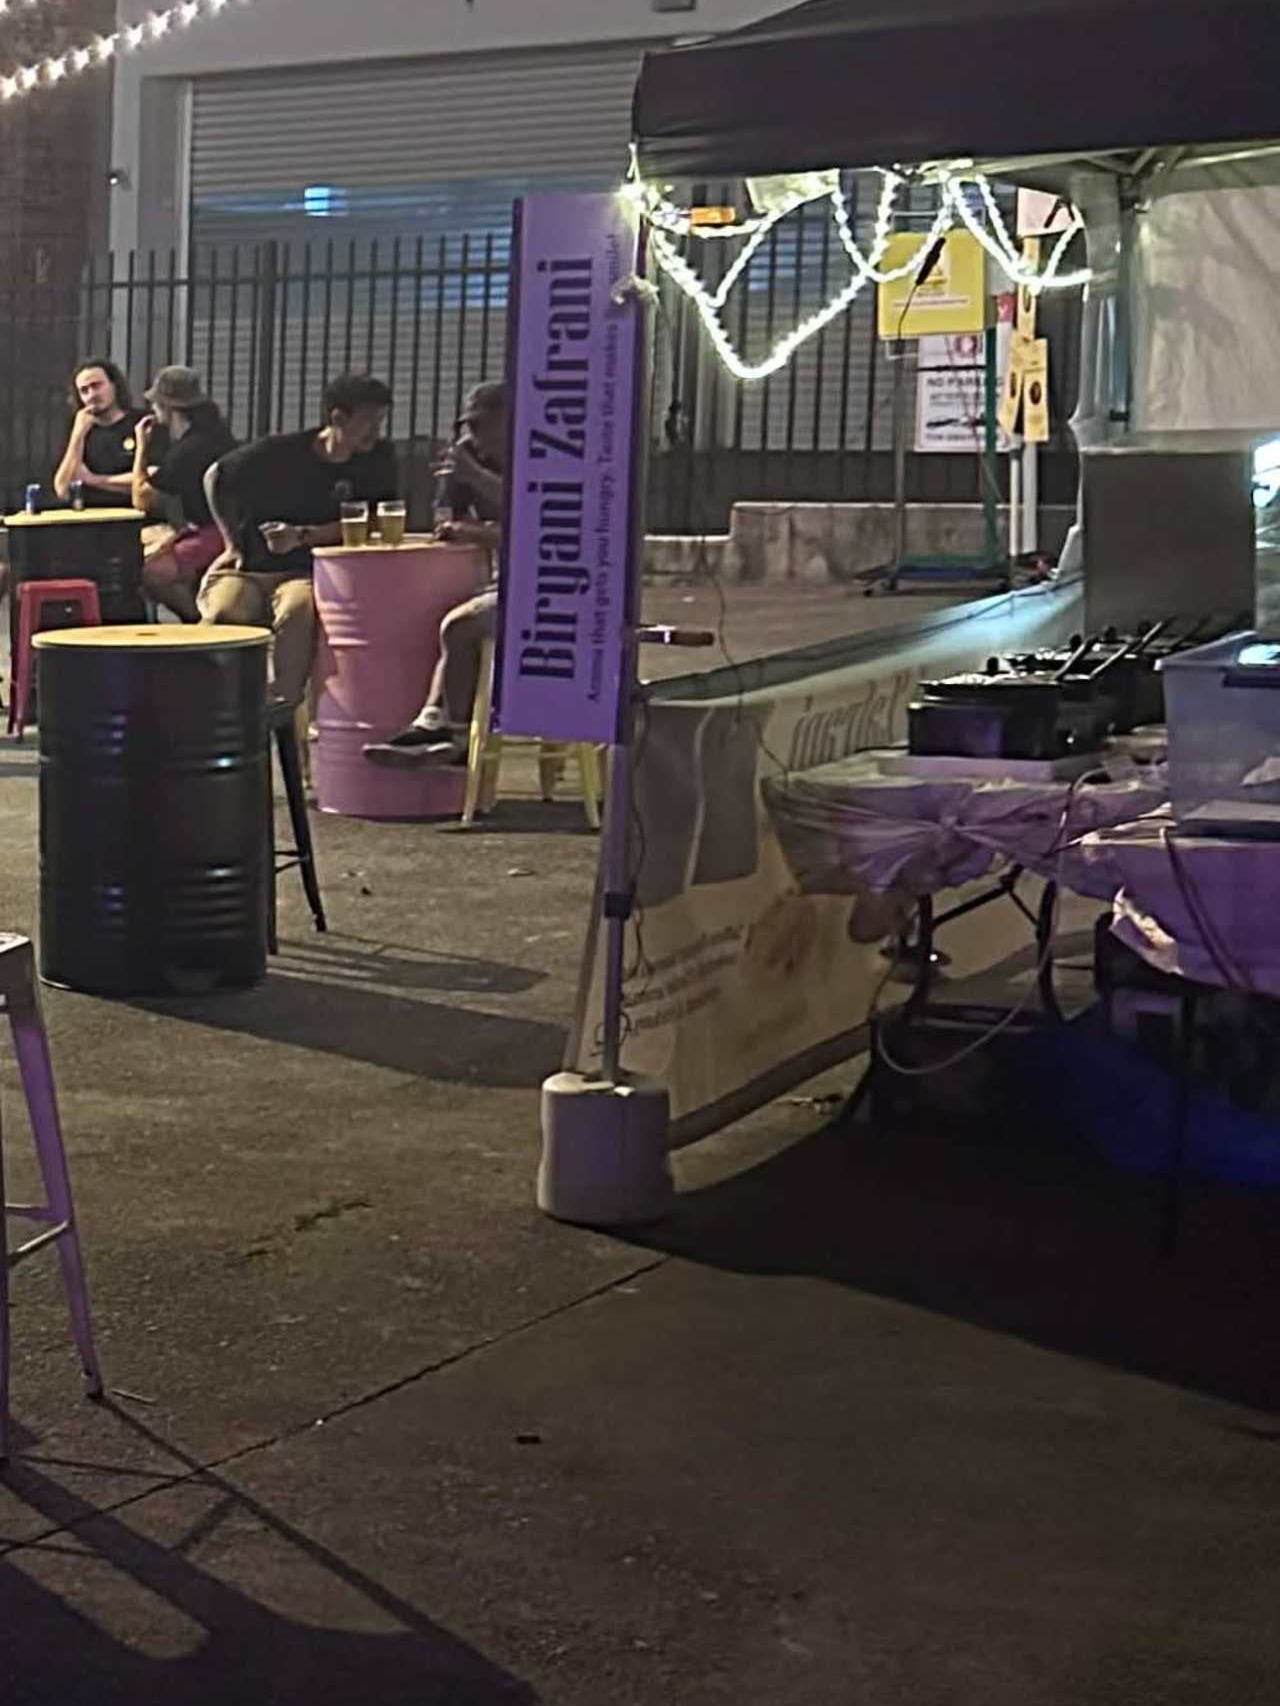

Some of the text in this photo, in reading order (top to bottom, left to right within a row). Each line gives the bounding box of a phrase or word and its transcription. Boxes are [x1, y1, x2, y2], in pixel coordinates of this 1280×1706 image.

[599, 381, 616, 417] that
[518, 255, 594, 681] Biryani Zafrani
[595, 536, 616, 568] you
[589, 610, 607, 645] that
